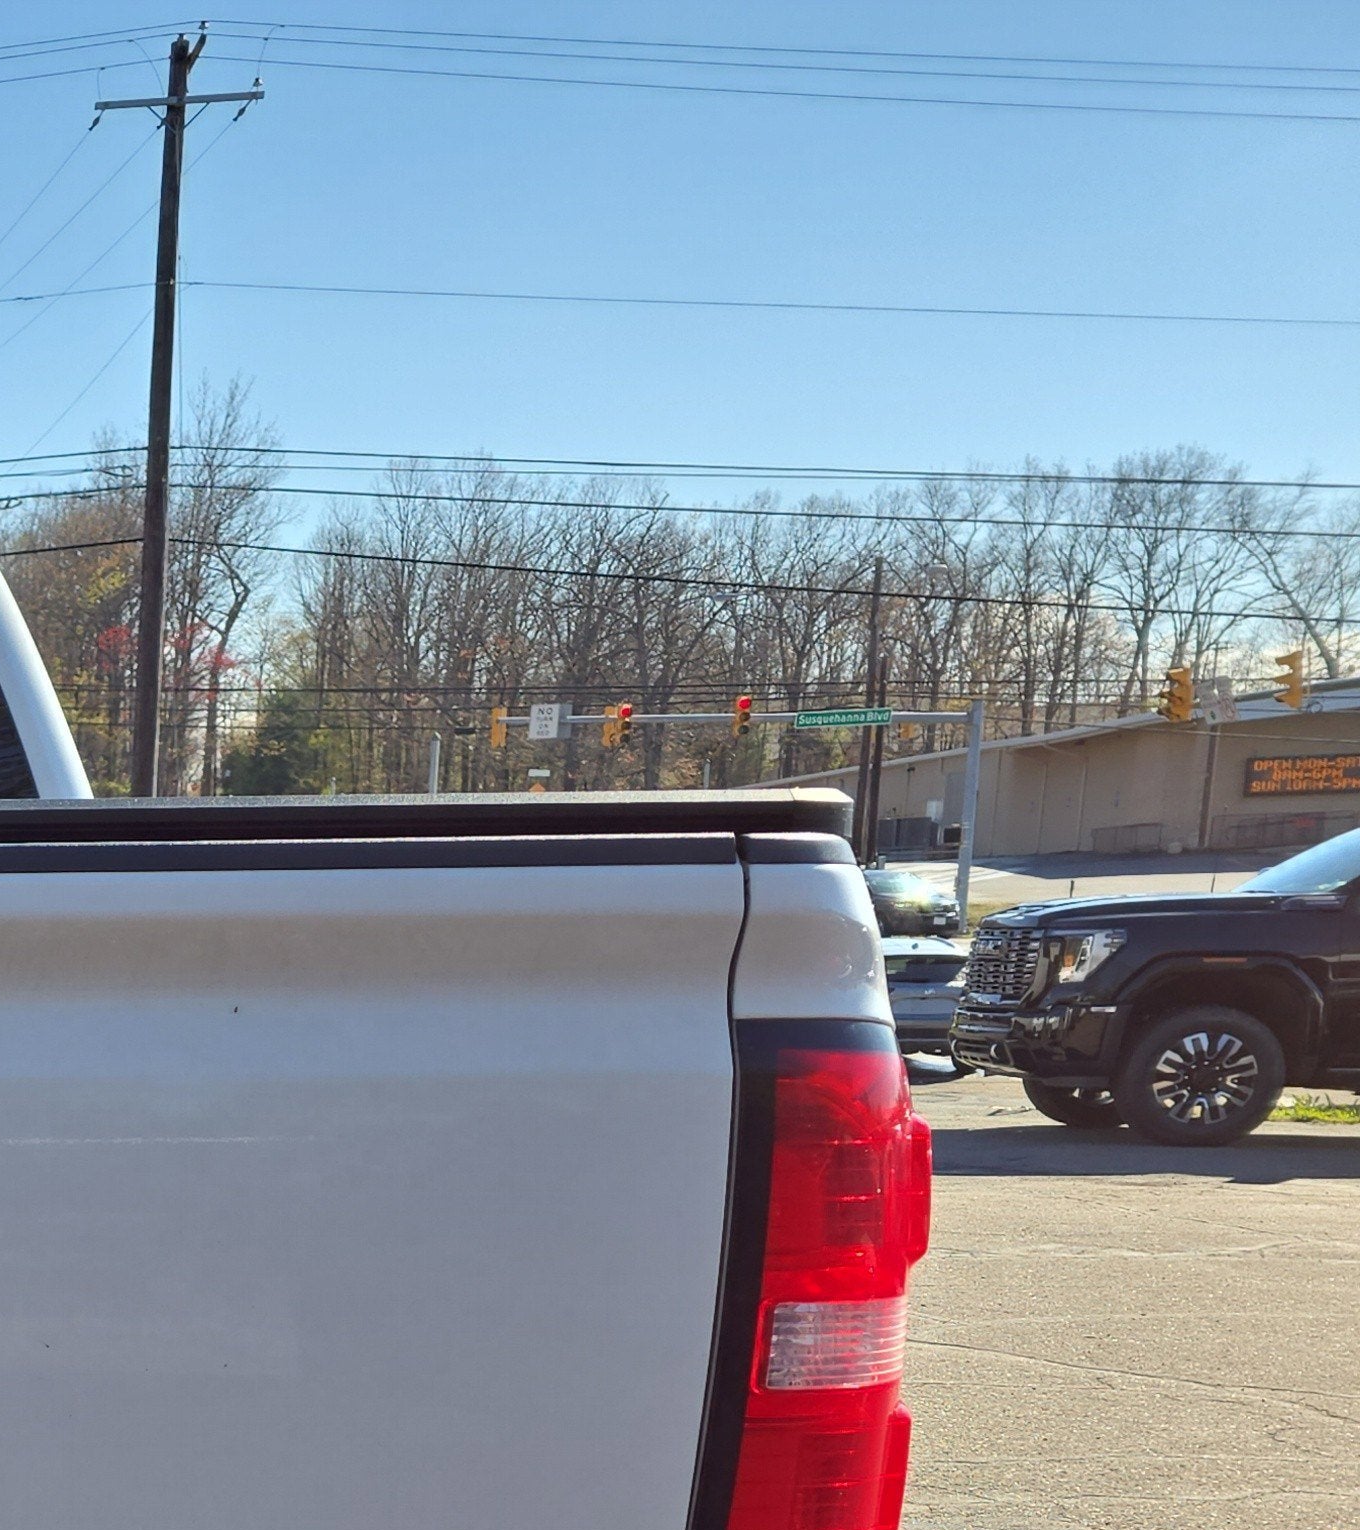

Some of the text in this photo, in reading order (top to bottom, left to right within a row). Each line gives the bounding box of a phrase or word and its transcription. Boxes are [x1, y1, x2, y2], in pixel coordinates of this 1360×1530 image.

[538, 707, 553, 715] NO
[798, 711, 890, 725] Susquehanna Blvd
[1253, 759, 1293, 771] OPEN
[1251, 780, 1281, 792] SUN
